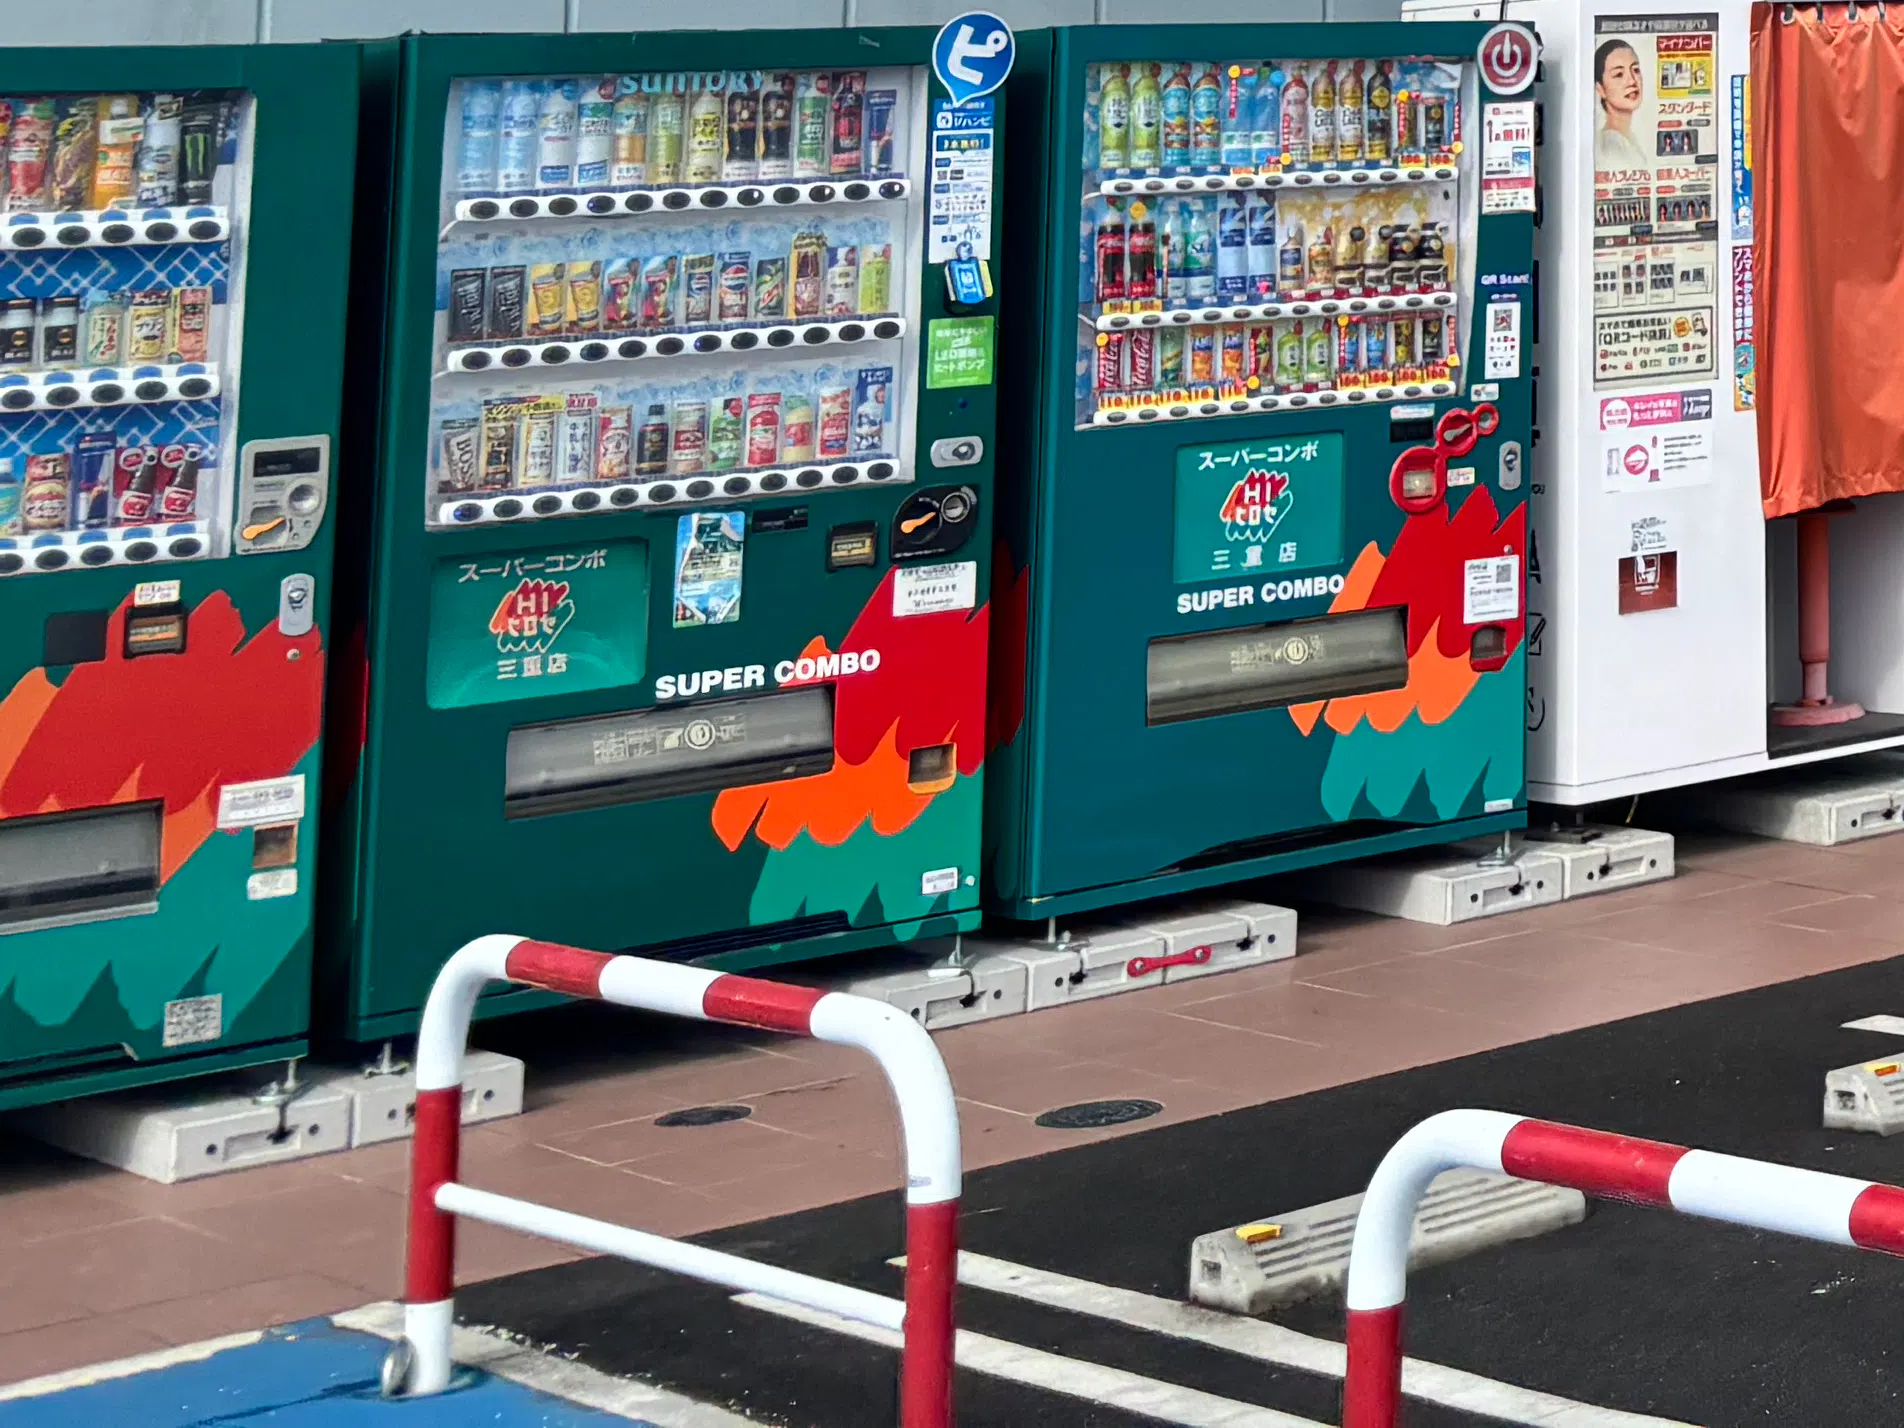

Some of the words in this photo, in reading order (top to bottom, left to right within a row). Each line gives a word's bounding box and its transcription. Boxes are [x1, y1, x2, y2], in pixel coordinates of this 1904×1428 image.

[1198, 439, 1320, 471] スーパーコンボ
[1245, 472, 1272, 505] HI
[1235, 504, 1279, 526] ヒロセ
[458, 547, 608, 583] スーパーコンボ
[517, 591, 549, 614] HI
[1177, 579, 1254, 614] SUPER
[1261, 573, 1345, 604] COMBO
[508, 613, 557, 637] ヒロセ
[655, 664, 766, 702] SUPER
[780, 649, 881, 684] COMBO
